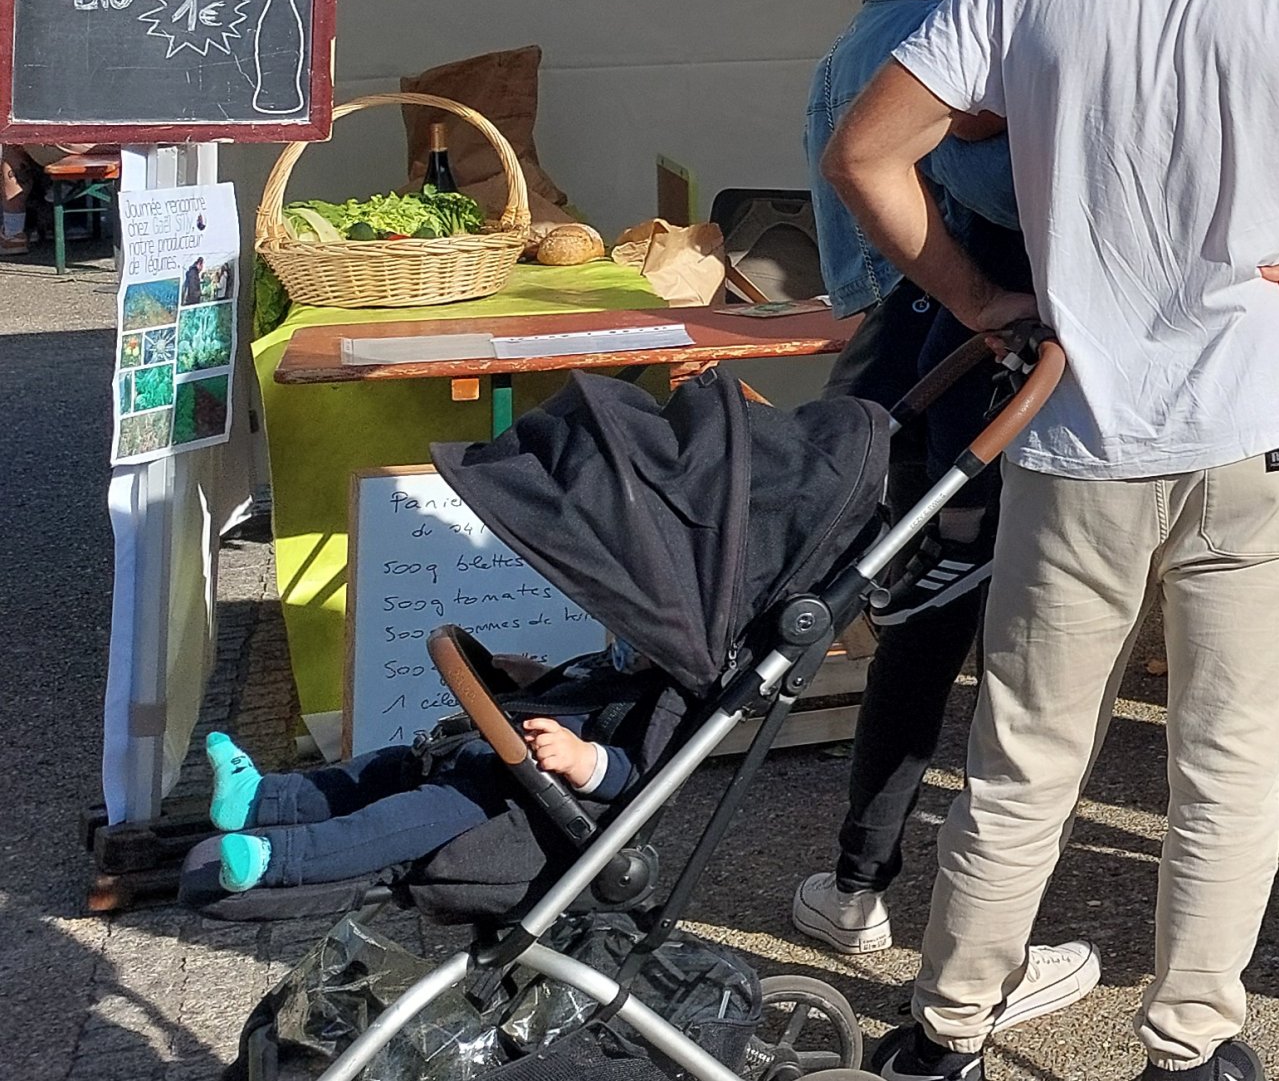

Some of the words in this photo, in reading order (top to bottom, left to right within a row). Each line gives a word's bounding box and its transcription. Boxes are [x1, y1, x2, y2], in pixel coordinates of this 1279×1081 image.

[128, 219, 150, 237] chez
[129, 238, 154, 256] notre
[158, 233, 203, 257] producteur
[129, 257, 140, 275] de
[384, 560, 438, 584] 500g
[456, 554, 526, 571] blettes
[384, 596, 445, 616] 500g
[454, 584, 552, 605] tomates
[459, 623, 520, 634] ommes
